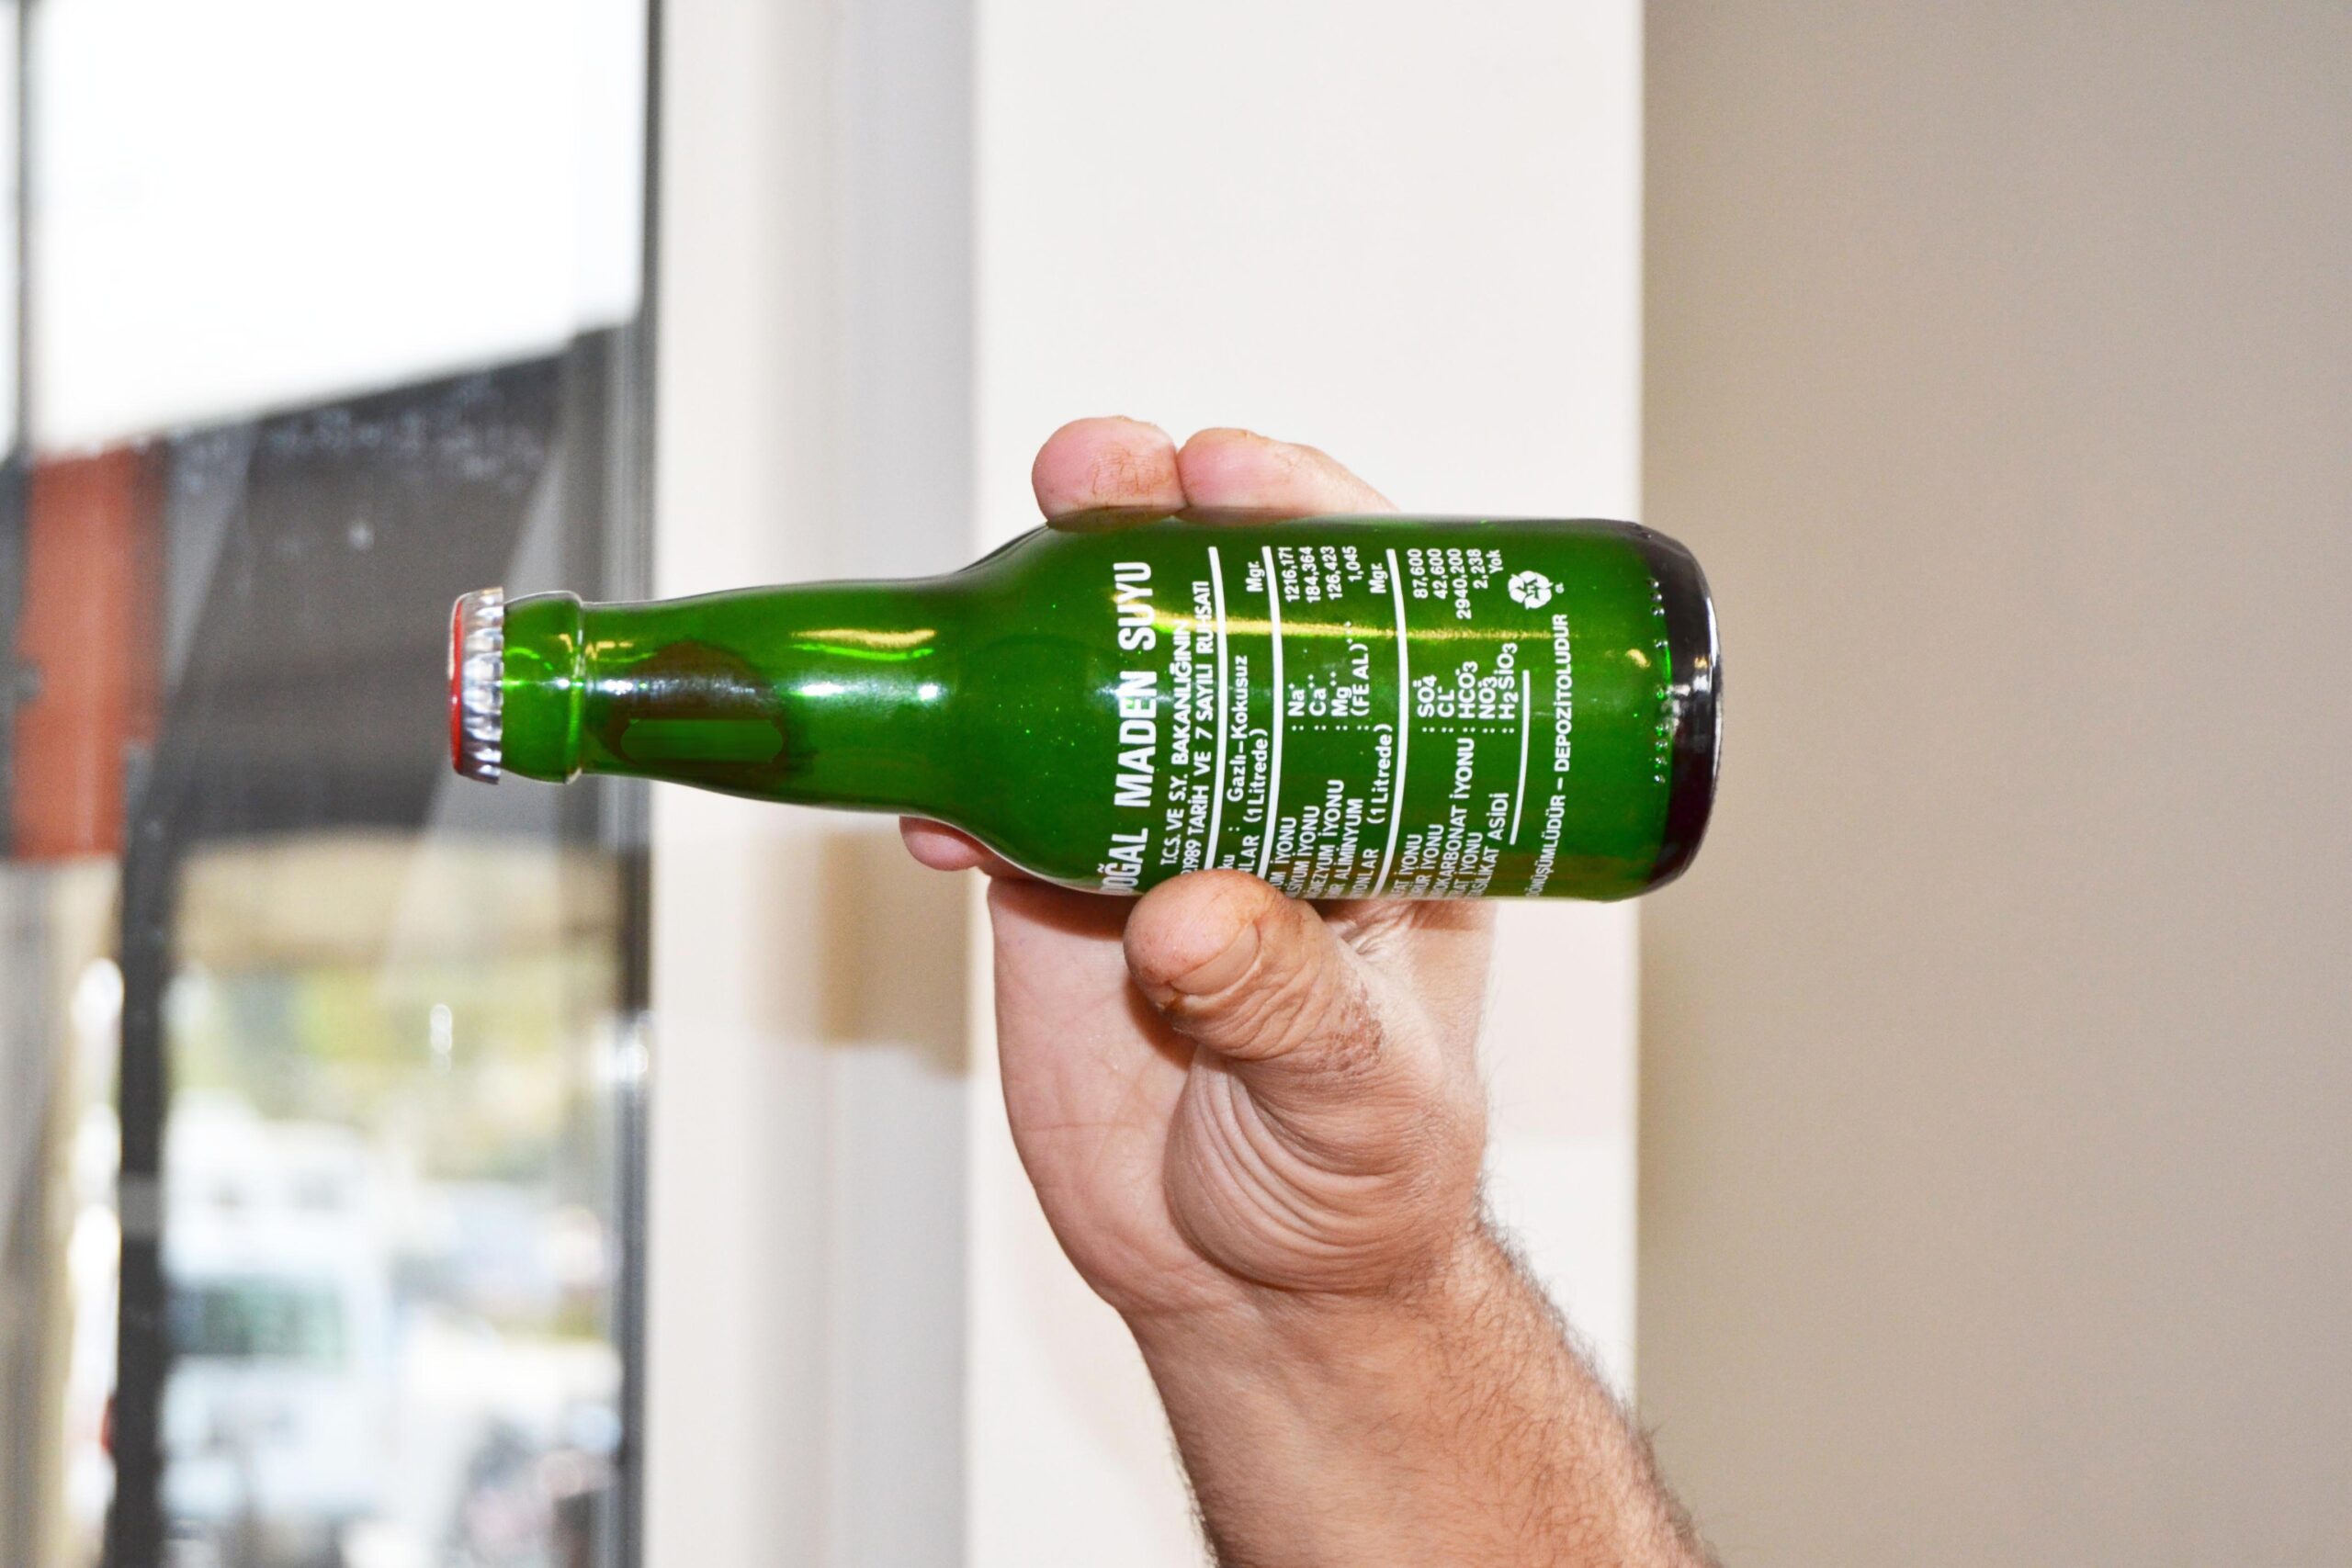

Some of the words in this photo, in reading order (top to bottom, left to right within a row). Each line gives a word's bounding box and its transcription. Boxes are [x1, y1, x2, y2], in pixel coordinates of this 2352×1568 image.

[1246, 561, 1264, 592] Mgr.
[1278, 547, 1300, 602] 1216,171
[1299, 547, 1321, 603] 184,364
[1320, 546, 1342, 599] 126,423
[1342, 546, 1363, 581] 1,045
[1368, 562, 1388, 593] Mgr.
[1427, 548, 1448, 599] 42,600
[1447, 548, 1472, 619] 2940,200
[1467, 549, 1488, 588] 2,238
[1487, 550, 1504, 573] Yok
[1113, 562, 1156, 650] SUYU
[1170, 620, 1192, 764] BAKANLIĞININ
[1196, 664, 1213, 721] SAYILI
[1394, 834, 1422, 874] İYONU
[1408, 548, 1429, 598] 87,600
[1553, 614, 1572, 772] DEPOZİTOLUDUR
[1114, 671, 1157, 807] MADEN
[1195, 726, 1213, 739] 7
[1169, 773, 1188, 801] S.Y.
[1193, 751, 1212, 775] VE
[1449, 738, 1475, 799] İYONU
[1166, 808, 1184, 830] VE
[1187, 785, 1209, 835] TARİH
[1293, 806, 1320, 856] İYONU
[1317, 779, 1344, 836] İYONU
[1487, 793, 1509, 840] ASİDİ
[1097, 829, 1148, 895] DOĞAL
[1217, 854, 1235, 869] ku
[1238, 835, 1260, 873] NLAR
[1270, 818, 1296, 863] İYONU
[1333, 798, 1363, 879] ALİMİNYUM
[1416, 824, 1444, 869] İYONU
[1454, 832, 1483, 874] İYONU
